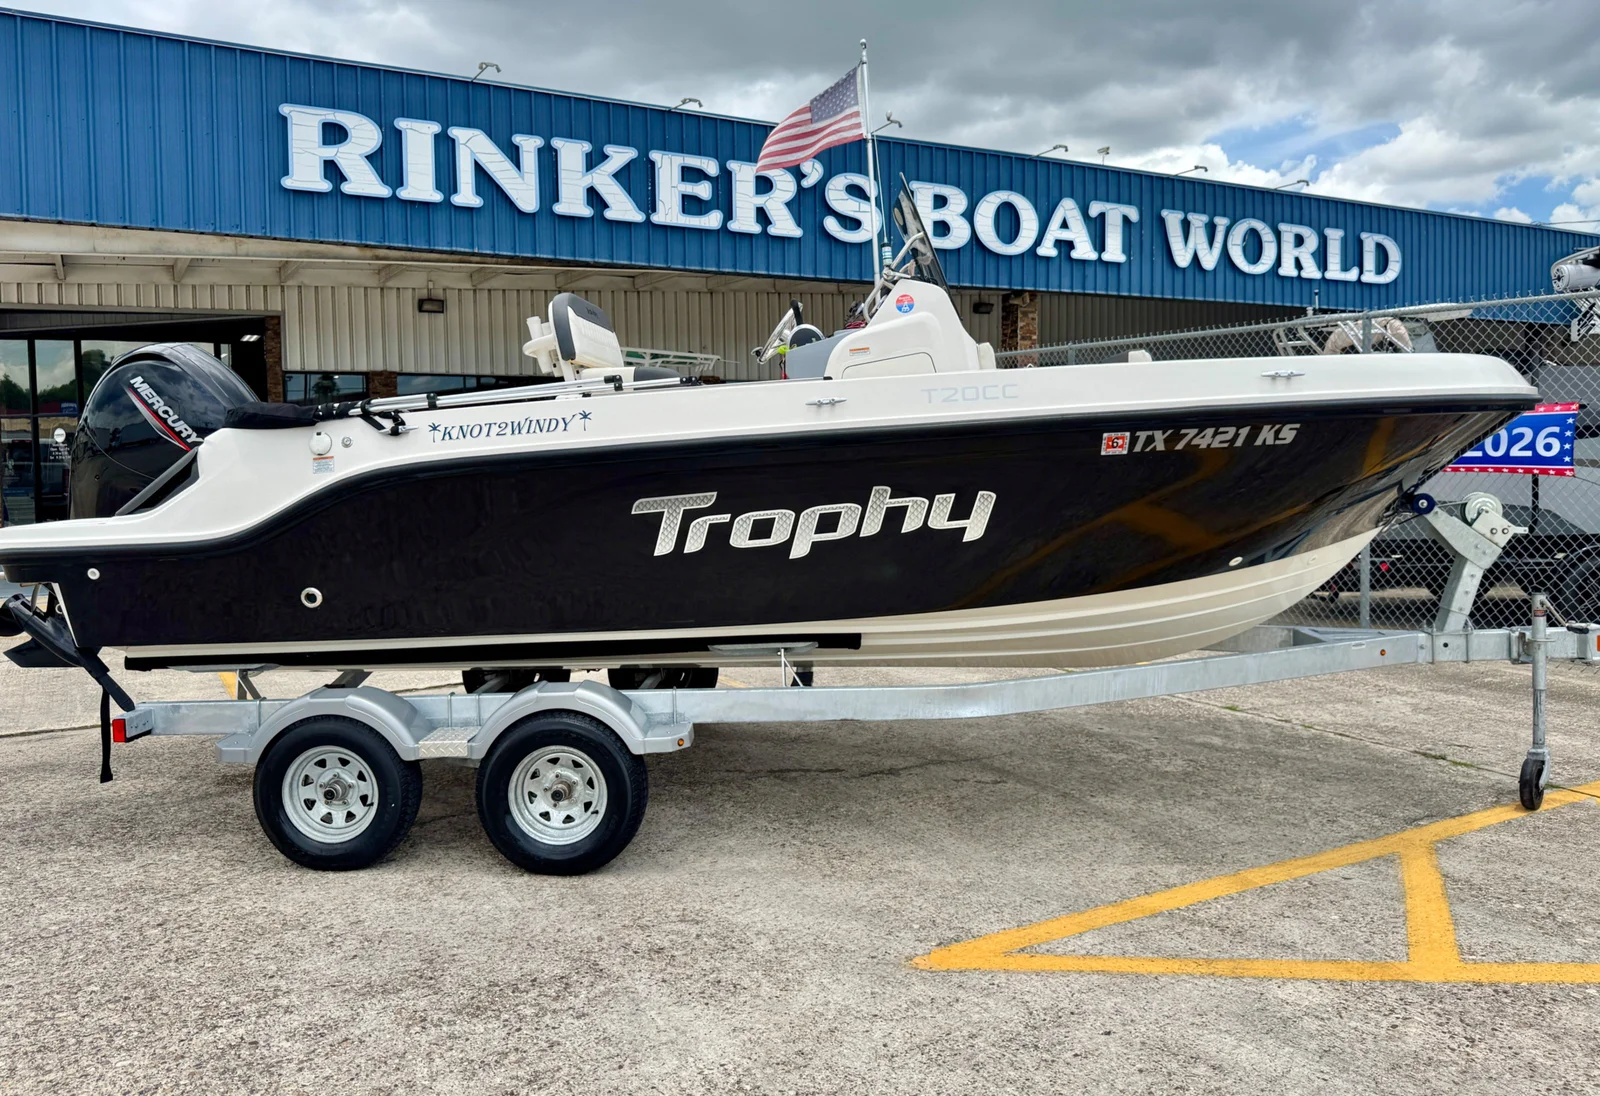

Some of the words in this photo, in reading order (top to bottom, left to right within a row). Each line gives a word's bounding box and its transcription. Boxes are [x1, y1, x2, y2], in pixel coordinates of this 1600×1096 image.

[279, 103, 882, 243] RINKER'S
[909, 180, 1139, 263] BOAT
[1161, 208, 1402, 285] WORLD
[129, 375, 204, 443] MERCURY
[920, 384, 1019, 404] T20CC
[441, 413, 578, 441] KNOT2WINDY
[1132, 429, 1174, 453] TX
[1174, 425, 1251, 450] 7421
[1254, 423, 1301, 446] KS
[1111, 436, 1119, 449] 6
[631, 485, 997, 560] Trophy
